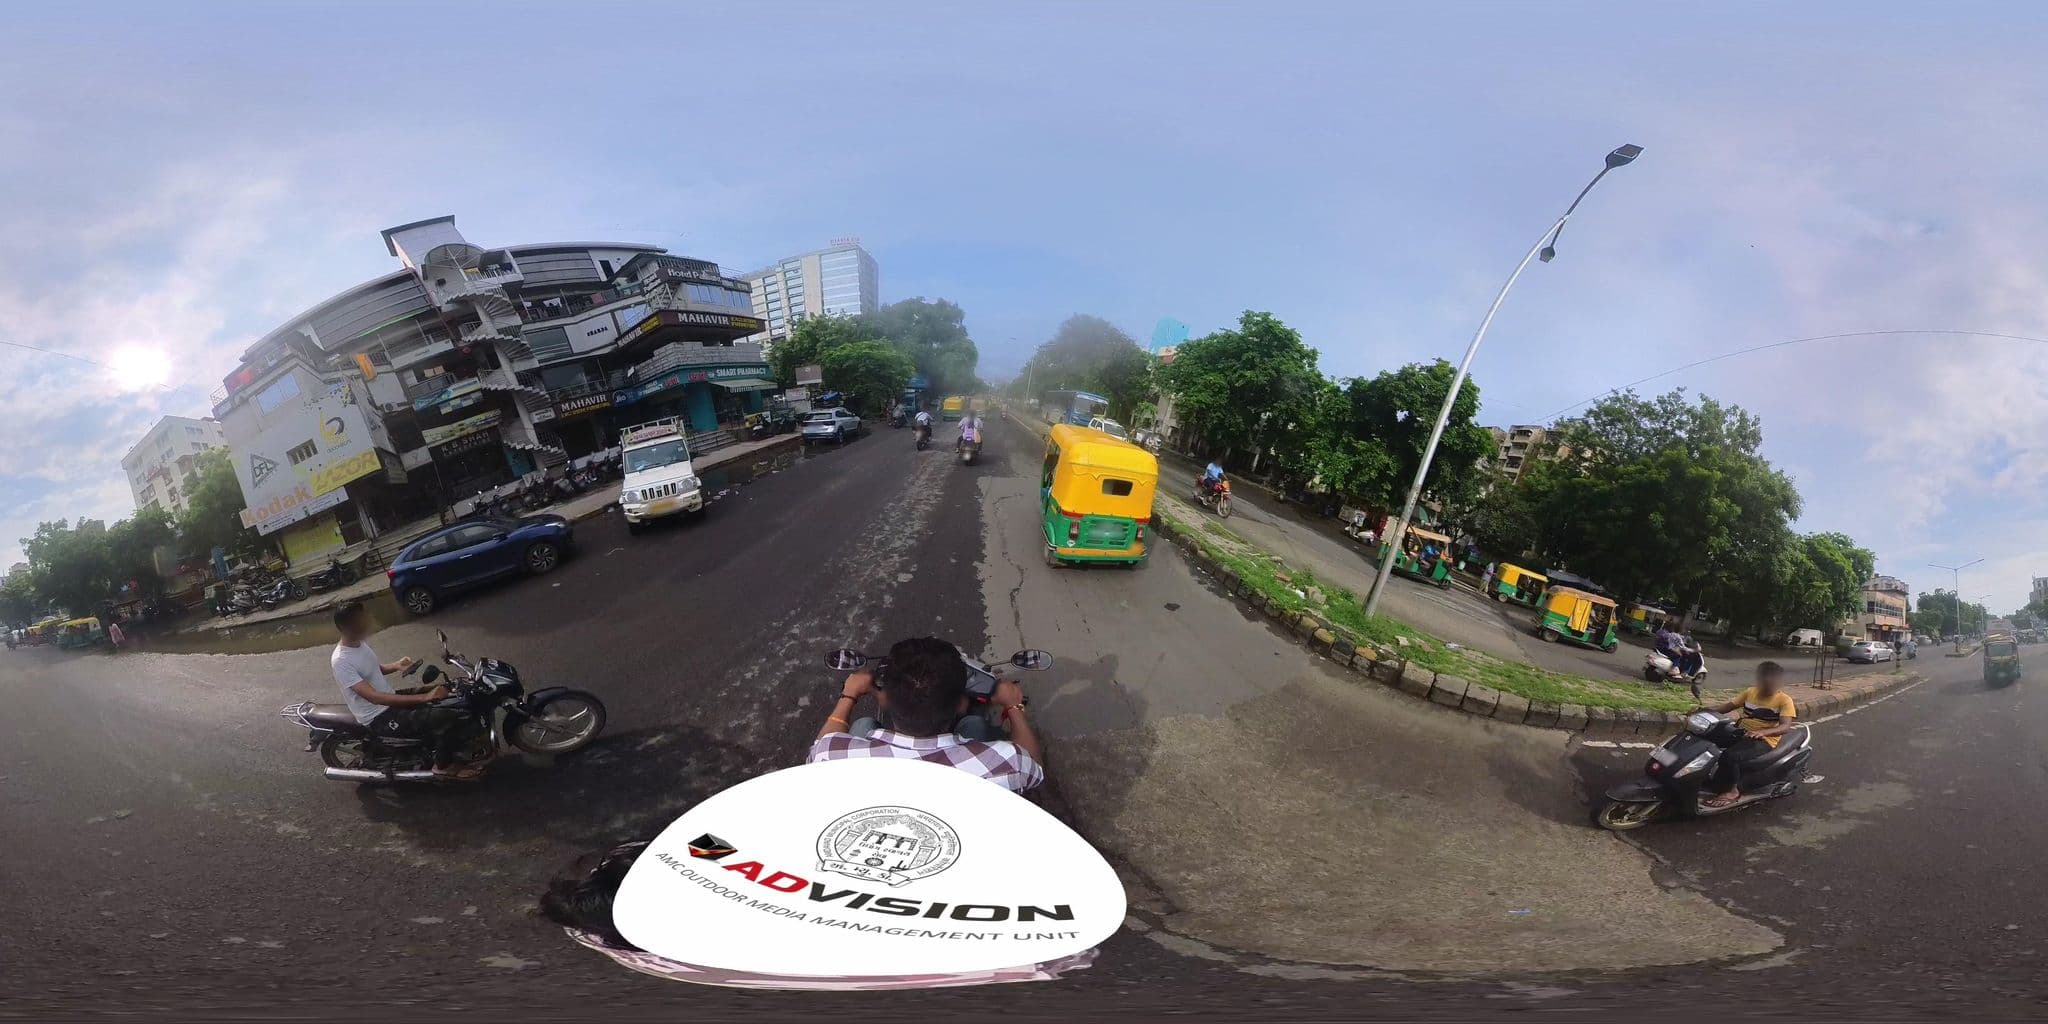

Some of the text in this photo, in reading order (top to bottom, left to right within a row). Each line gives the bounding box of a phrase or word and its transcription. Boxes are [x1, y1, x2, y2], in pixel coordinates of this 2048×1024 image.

[677, 312, 729, 325] MAHAVIR
[716, 369, 736, 377] SMART
[738, 367, 765, 376] PHARMACY
[561, 394, 607, 412] MAHAVIR
[253, 461, 274, 479] DFL
[243, 483, 312, 526] Kodak
